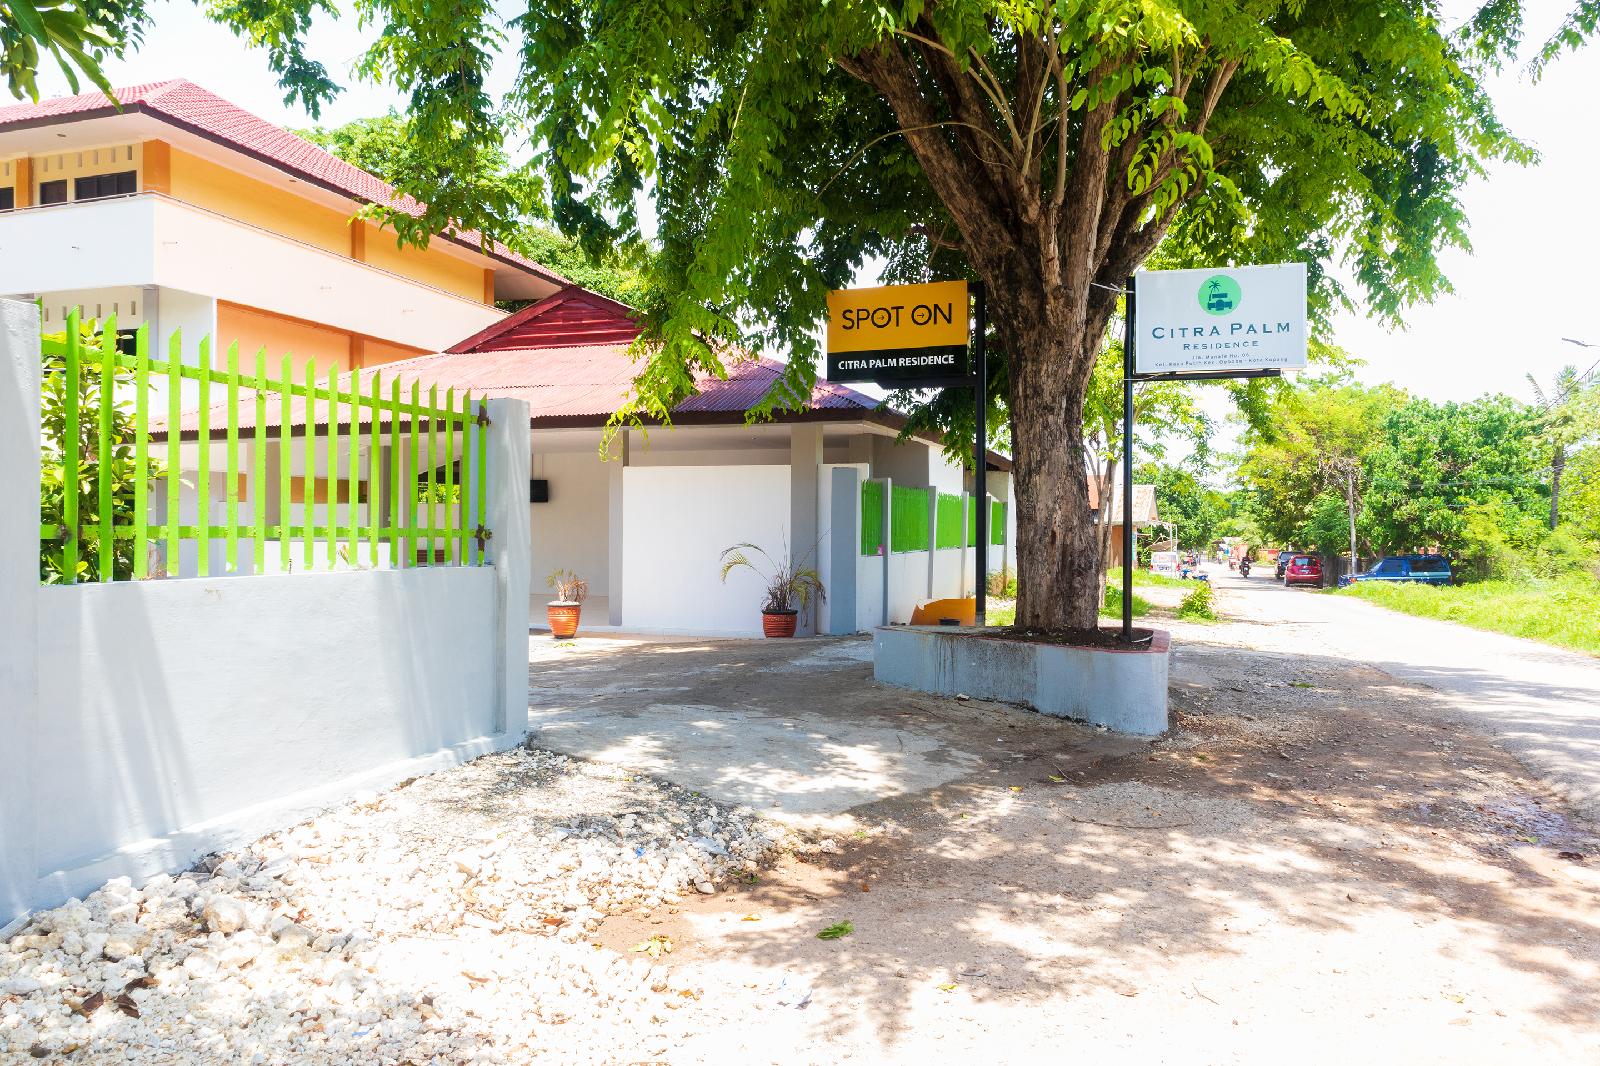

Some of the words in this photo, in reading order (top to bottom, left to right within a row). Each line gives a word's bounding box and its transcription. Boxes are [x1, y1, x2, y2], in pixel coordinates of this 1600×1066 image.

[841, 305, 905, 331] SPOT
[911, 302, 953, 326] ON
[1151, 325, 1221, 340] CITRA
[1230, 322, 1291, 336] PALM
[1183, 340, 1260, 351] RESIDENCE
[837, 358, 868, 370] CITRA
[869, 357, 897, 369] PALM
[898, 354, 955, 367] RESIDENCE
